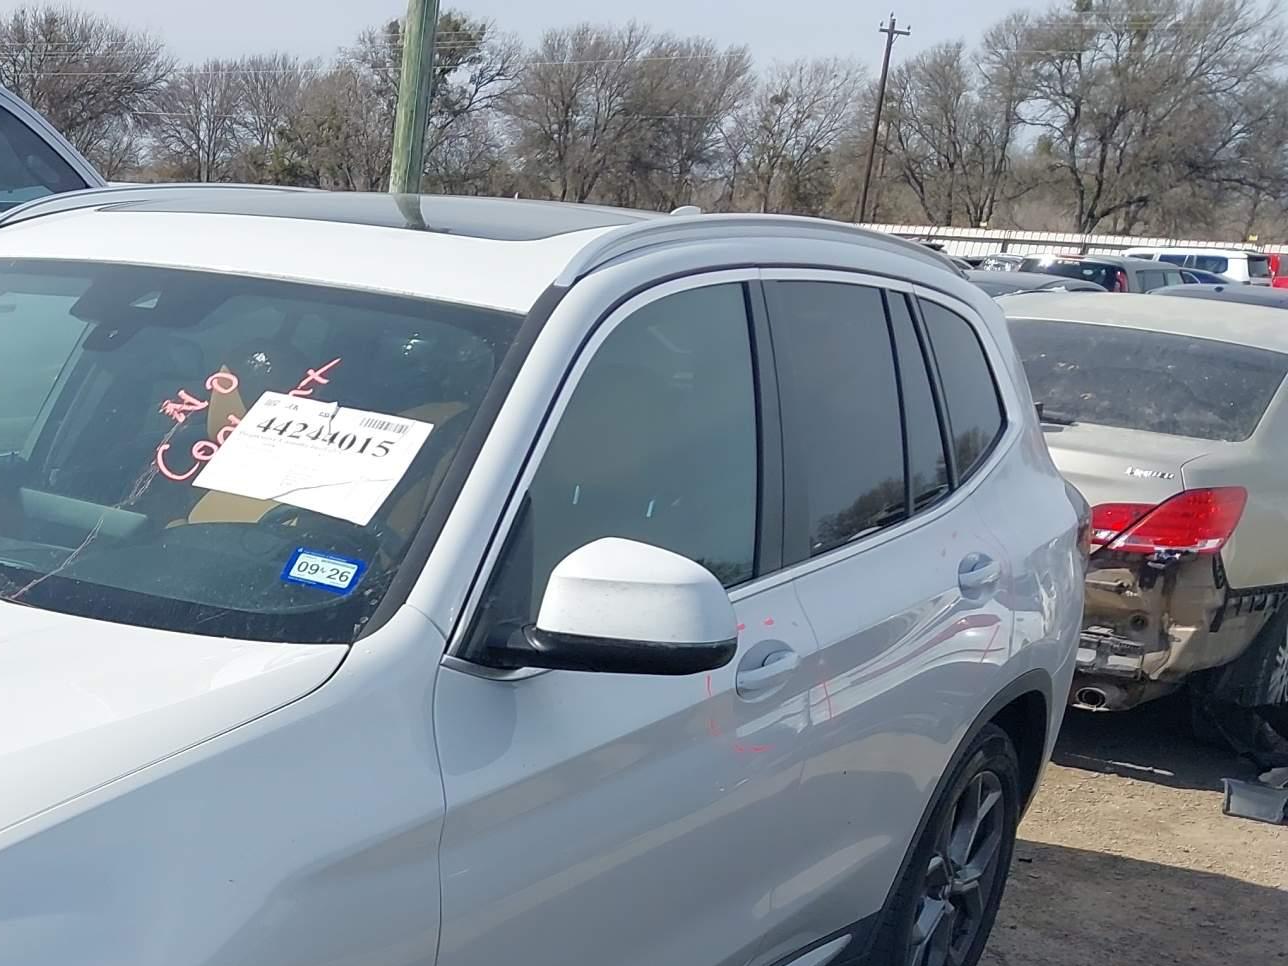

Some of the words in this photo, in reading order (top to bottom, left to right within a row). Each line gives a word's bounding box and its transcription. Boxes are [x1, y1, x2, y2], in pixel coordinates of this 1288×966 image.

[257, 417, 395, 457] 44244015
[297, 561, 320, 575] 09
[326, 568, 351, 583] 26
